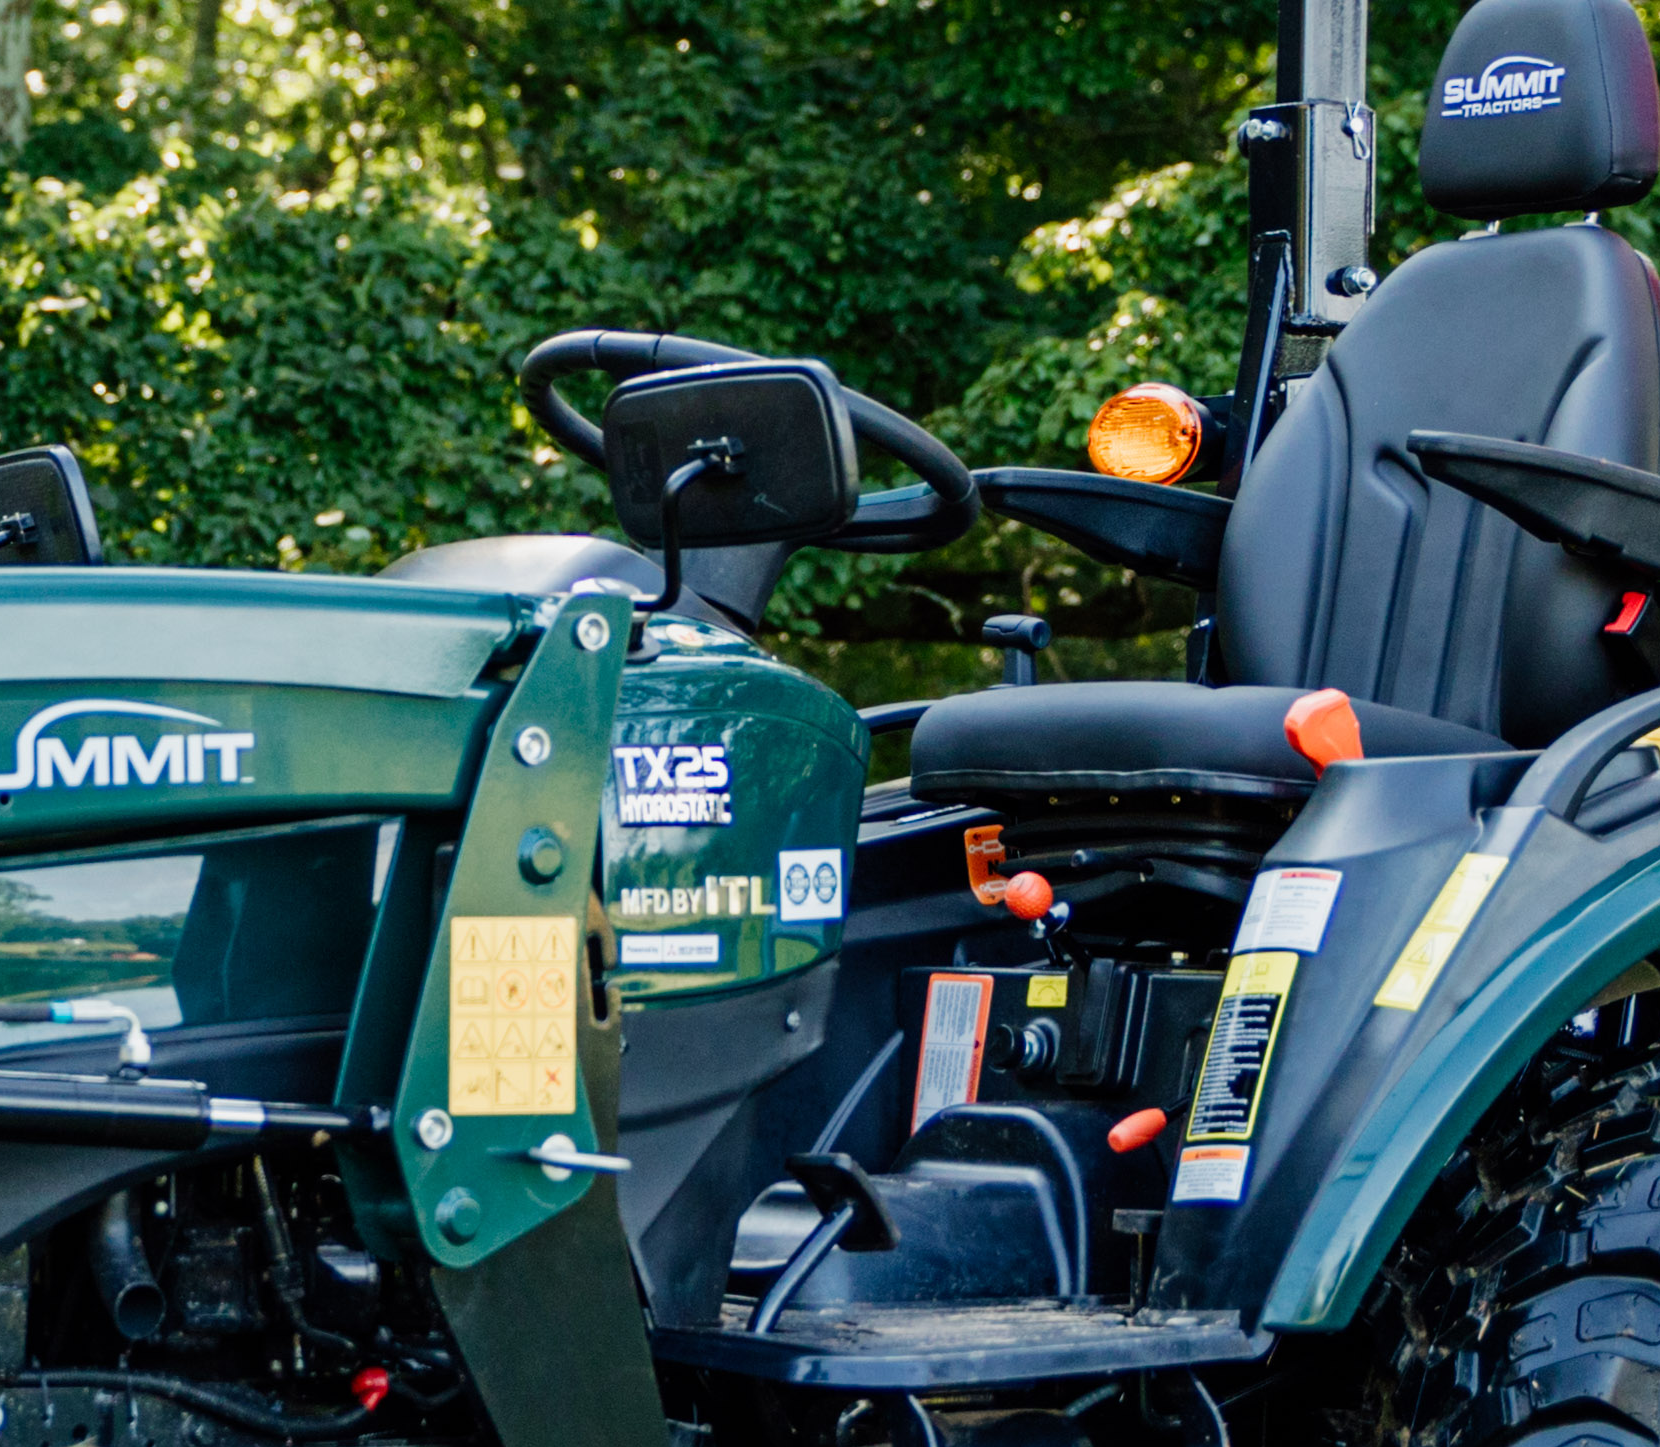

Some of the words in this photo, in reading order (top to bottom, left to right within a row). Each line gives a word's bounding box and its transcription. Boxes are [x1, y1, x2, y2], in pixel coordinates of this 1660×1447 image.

[1444, 56, 1565, 104] SUMMIT
[1462, 96, 1542, 118] TRACTORS
[613, 746, 729, 789] TX25
[619, 793, 732, 824] HYDROSTATIC
[621, 888, 670, 915] MFD
[672, 888, 702, 914] BY
[705, 875, 777, 915] ITL
